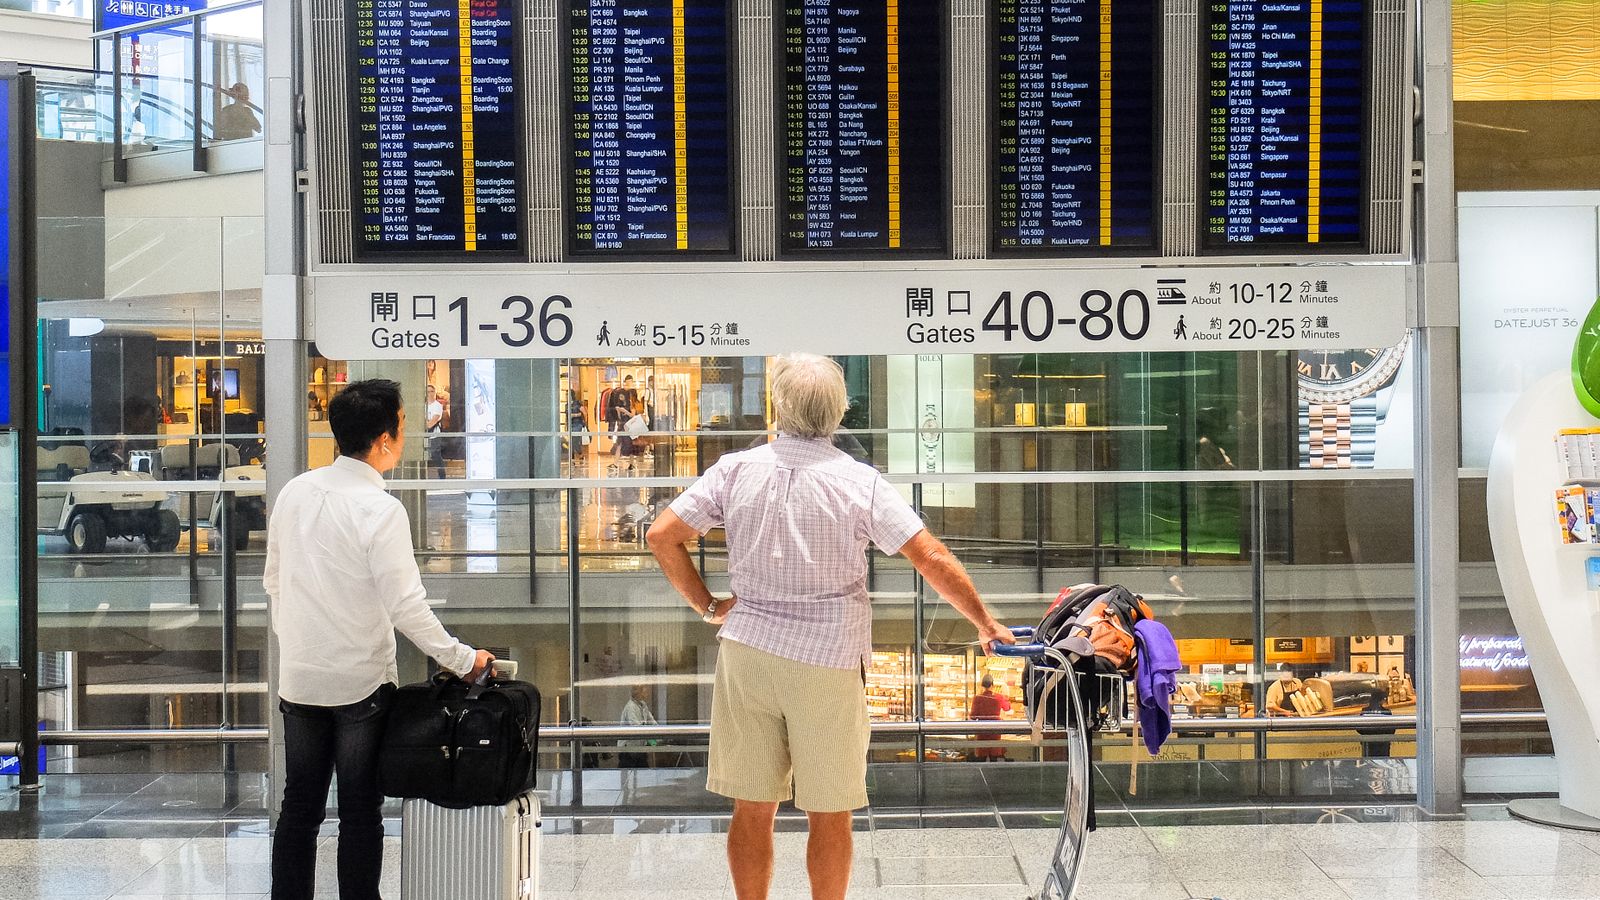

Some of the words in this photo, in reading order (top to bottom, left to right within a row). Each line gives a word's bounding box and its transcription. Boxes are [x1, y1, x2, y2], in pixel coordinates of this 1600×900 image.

[624, 9, 648, 17] Bangkok
[410, 39, 429, 47] Beijing
[412, 77, 435, 85] Bangkok
[1261, 153, 1288, 161] Singapore
[1209, 281, 1221, 294] 約
[1229, 282, 1293, 304] 10-12
[1299, 280, 1329, 293] 分鐘
[1191, 295, 1222, 305] About
[1299, 294, 1339, 304] Minutes
[371, 327, 440, 348] Gates
[448, 294, 573, 347] 1-36
[906, 323, 975, 344] Gates
[981, 289, 1150, 342] 40-80
[1209, 317, 1222, 330] 約
[1228, 318, 1295, 340] 20-25
[1300, 316, 1329, 329] 分鐘
[1494, 318, 1558, 329] DATEJUST
[1562, 318, 1579, 328] 36
[634, 323, 647, 336] 約
[652, 324, 705, 345] 5-15
[710, 323, 739, 336] 分鐘
[1192, 331, 1222, 341] About
[1301, 330, 1340, 339] Minutes
[616, 337, 646, 346] About
[710, 336, 750, 346] Minutes
